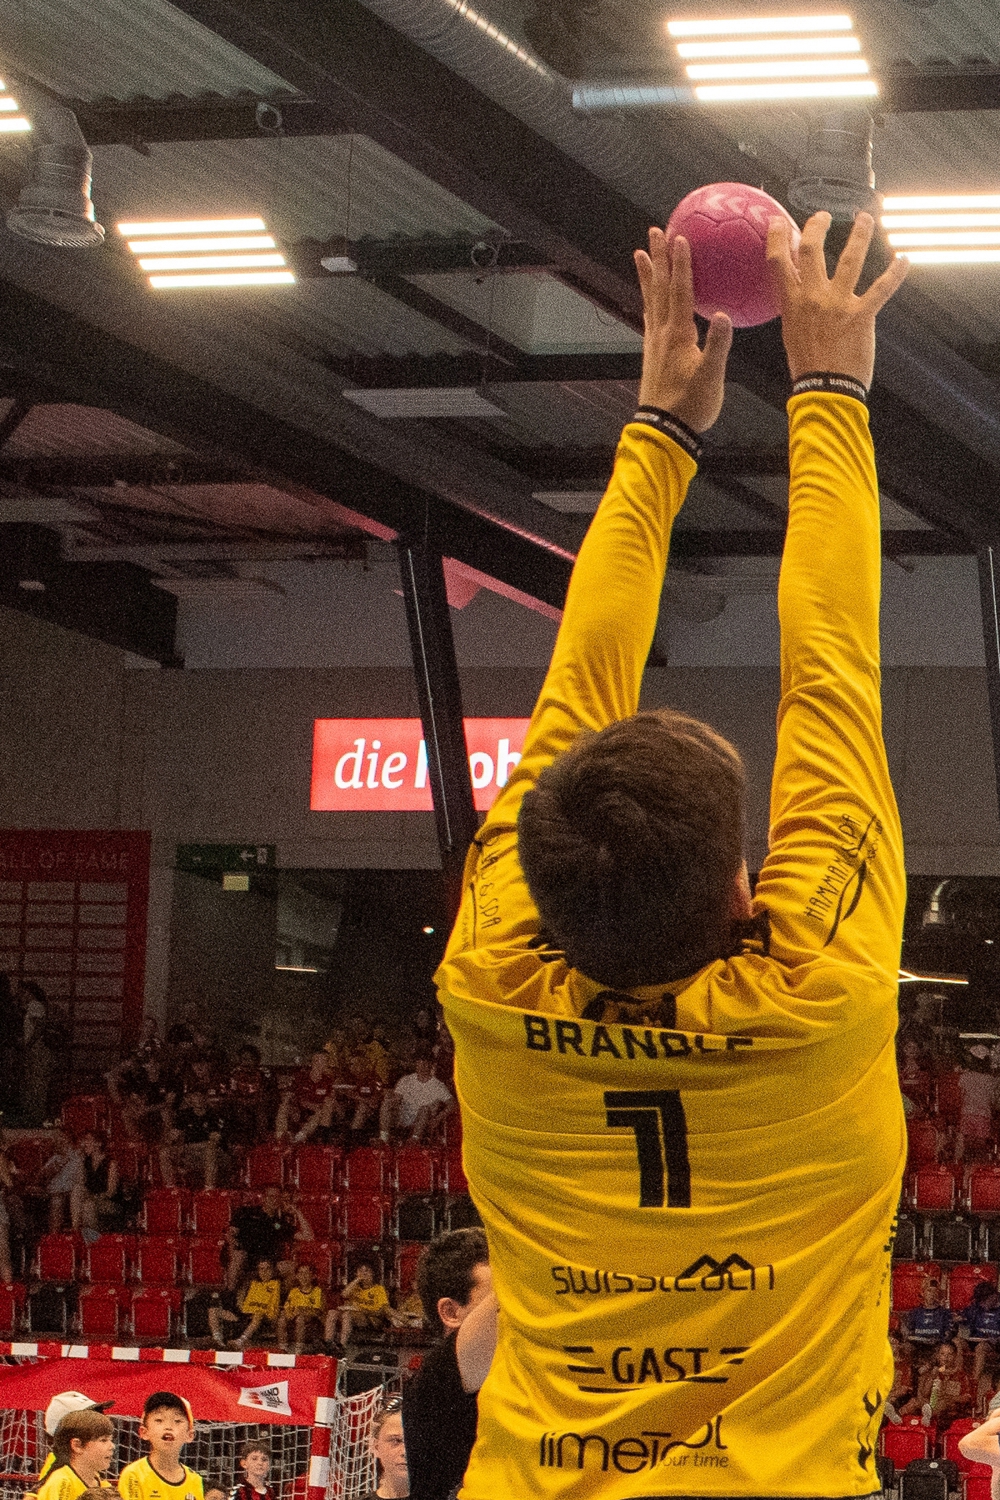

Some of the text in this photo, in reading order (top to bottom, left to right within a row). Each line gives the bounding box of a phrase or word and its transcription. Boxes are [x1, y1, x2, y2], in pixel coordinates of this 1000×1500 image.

[334, 738, 408, 789] die
[611, 1346, 709, 1384] GAST
[693, 1453, 729, 1468] time
